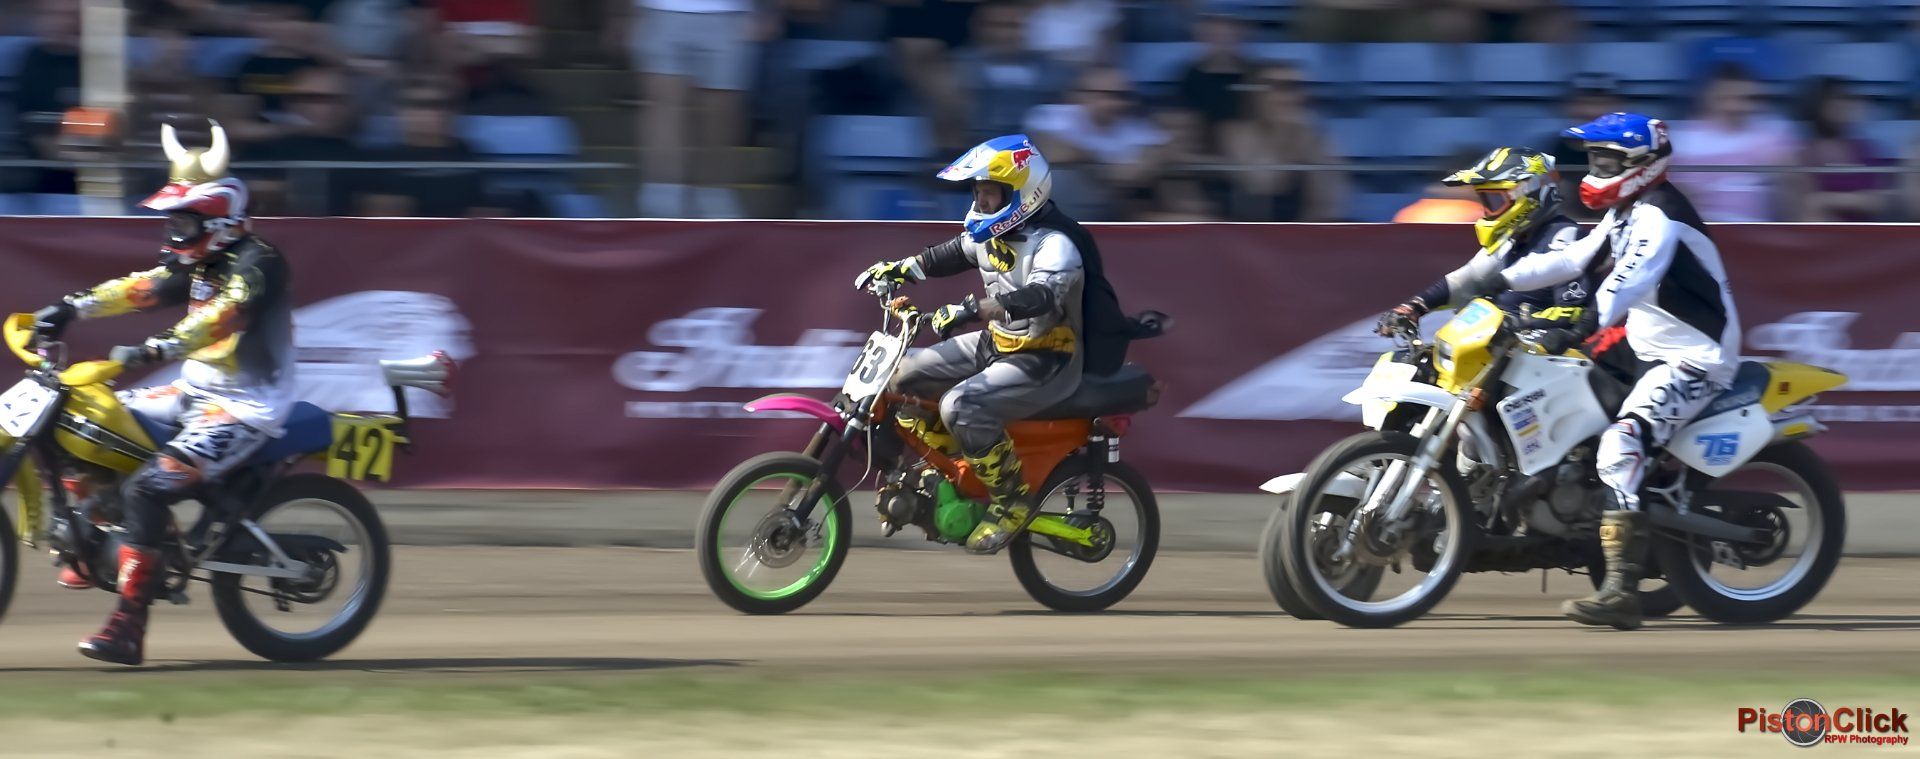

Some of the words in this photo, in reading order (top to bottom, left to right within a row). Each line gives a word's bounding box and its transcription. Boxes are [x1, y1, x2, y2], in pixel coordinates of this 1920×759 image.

[990, 212, 1021, 235] Red
[1021, 187, 1043, 215] Bull
[850, 339, 887, 384] 63
[336, 424, 383, 481] 42
[1695, 432, 1740, 457] 76
